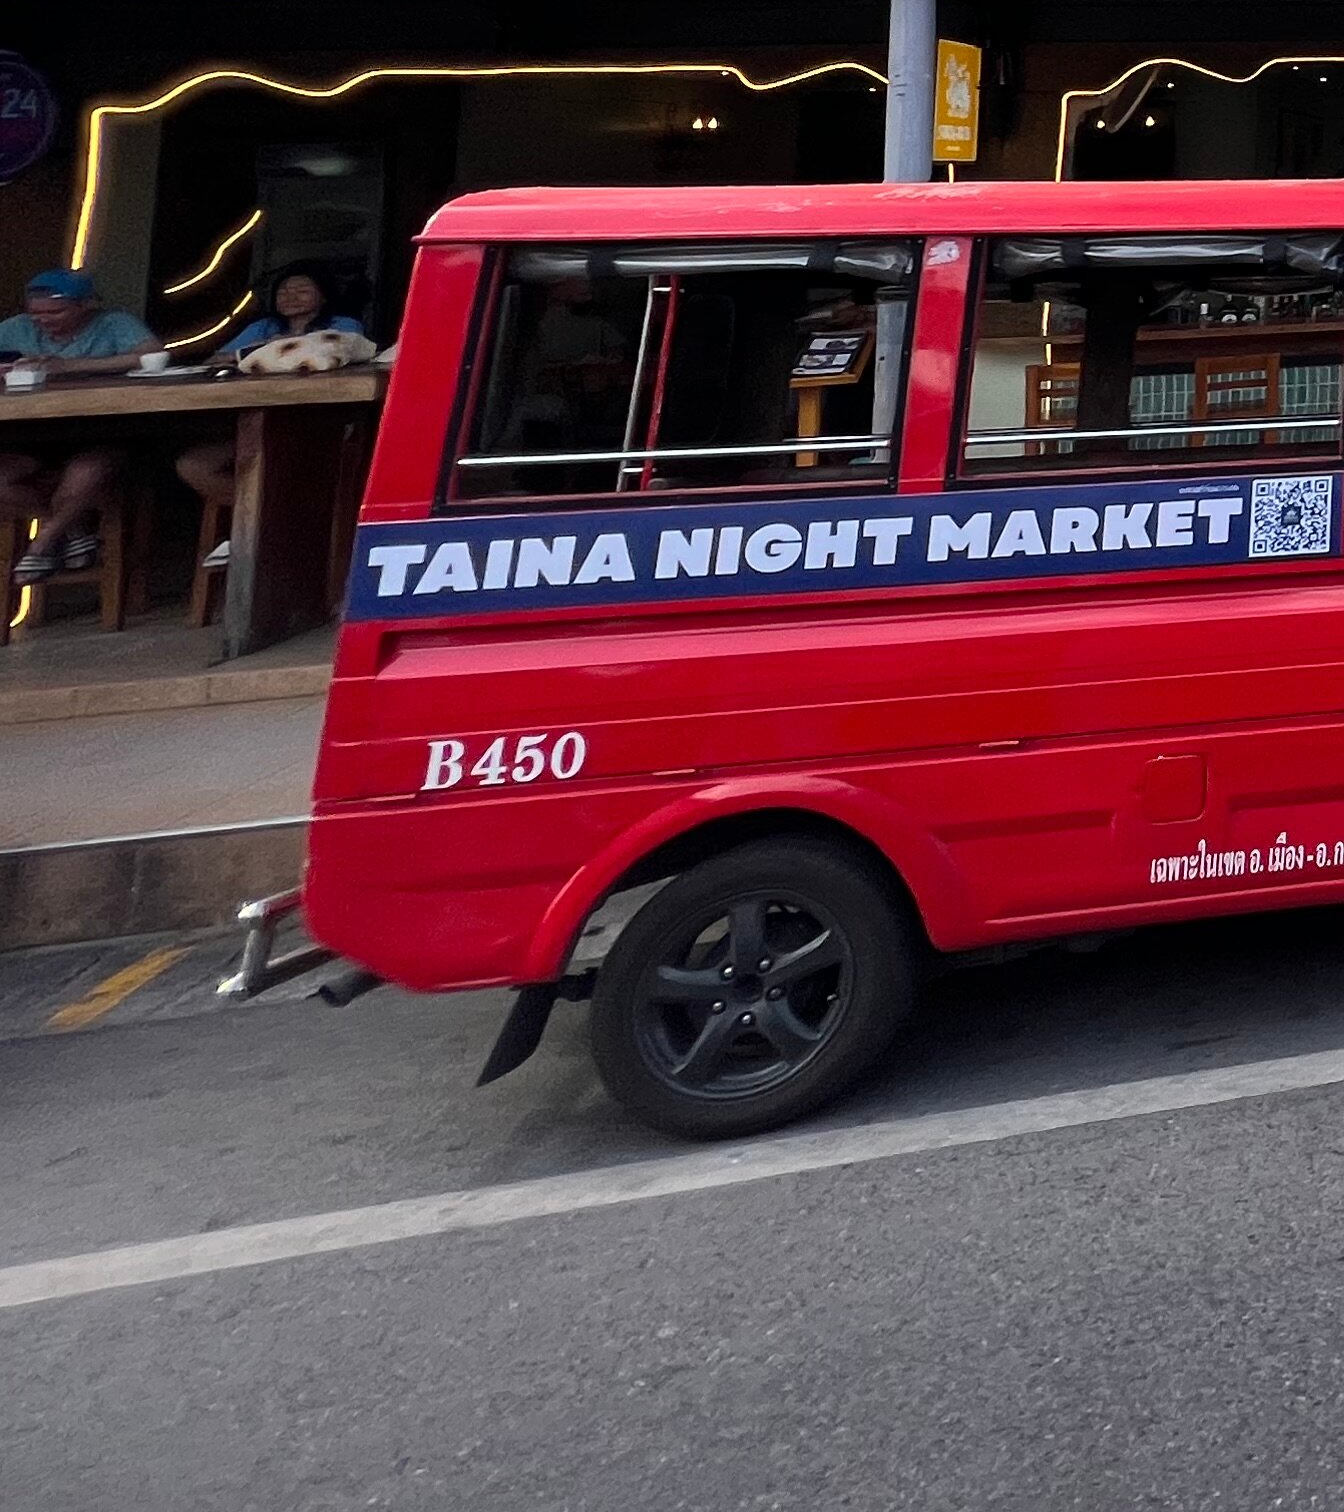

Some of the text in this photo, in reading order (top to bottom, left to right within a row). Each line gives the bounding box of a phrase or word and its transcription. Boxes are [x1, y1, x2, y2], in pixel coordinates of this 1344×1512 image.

[367, 498, 1244, 598] TAINA NIGHT MARKET
[420, 731, 587, 791] B450
